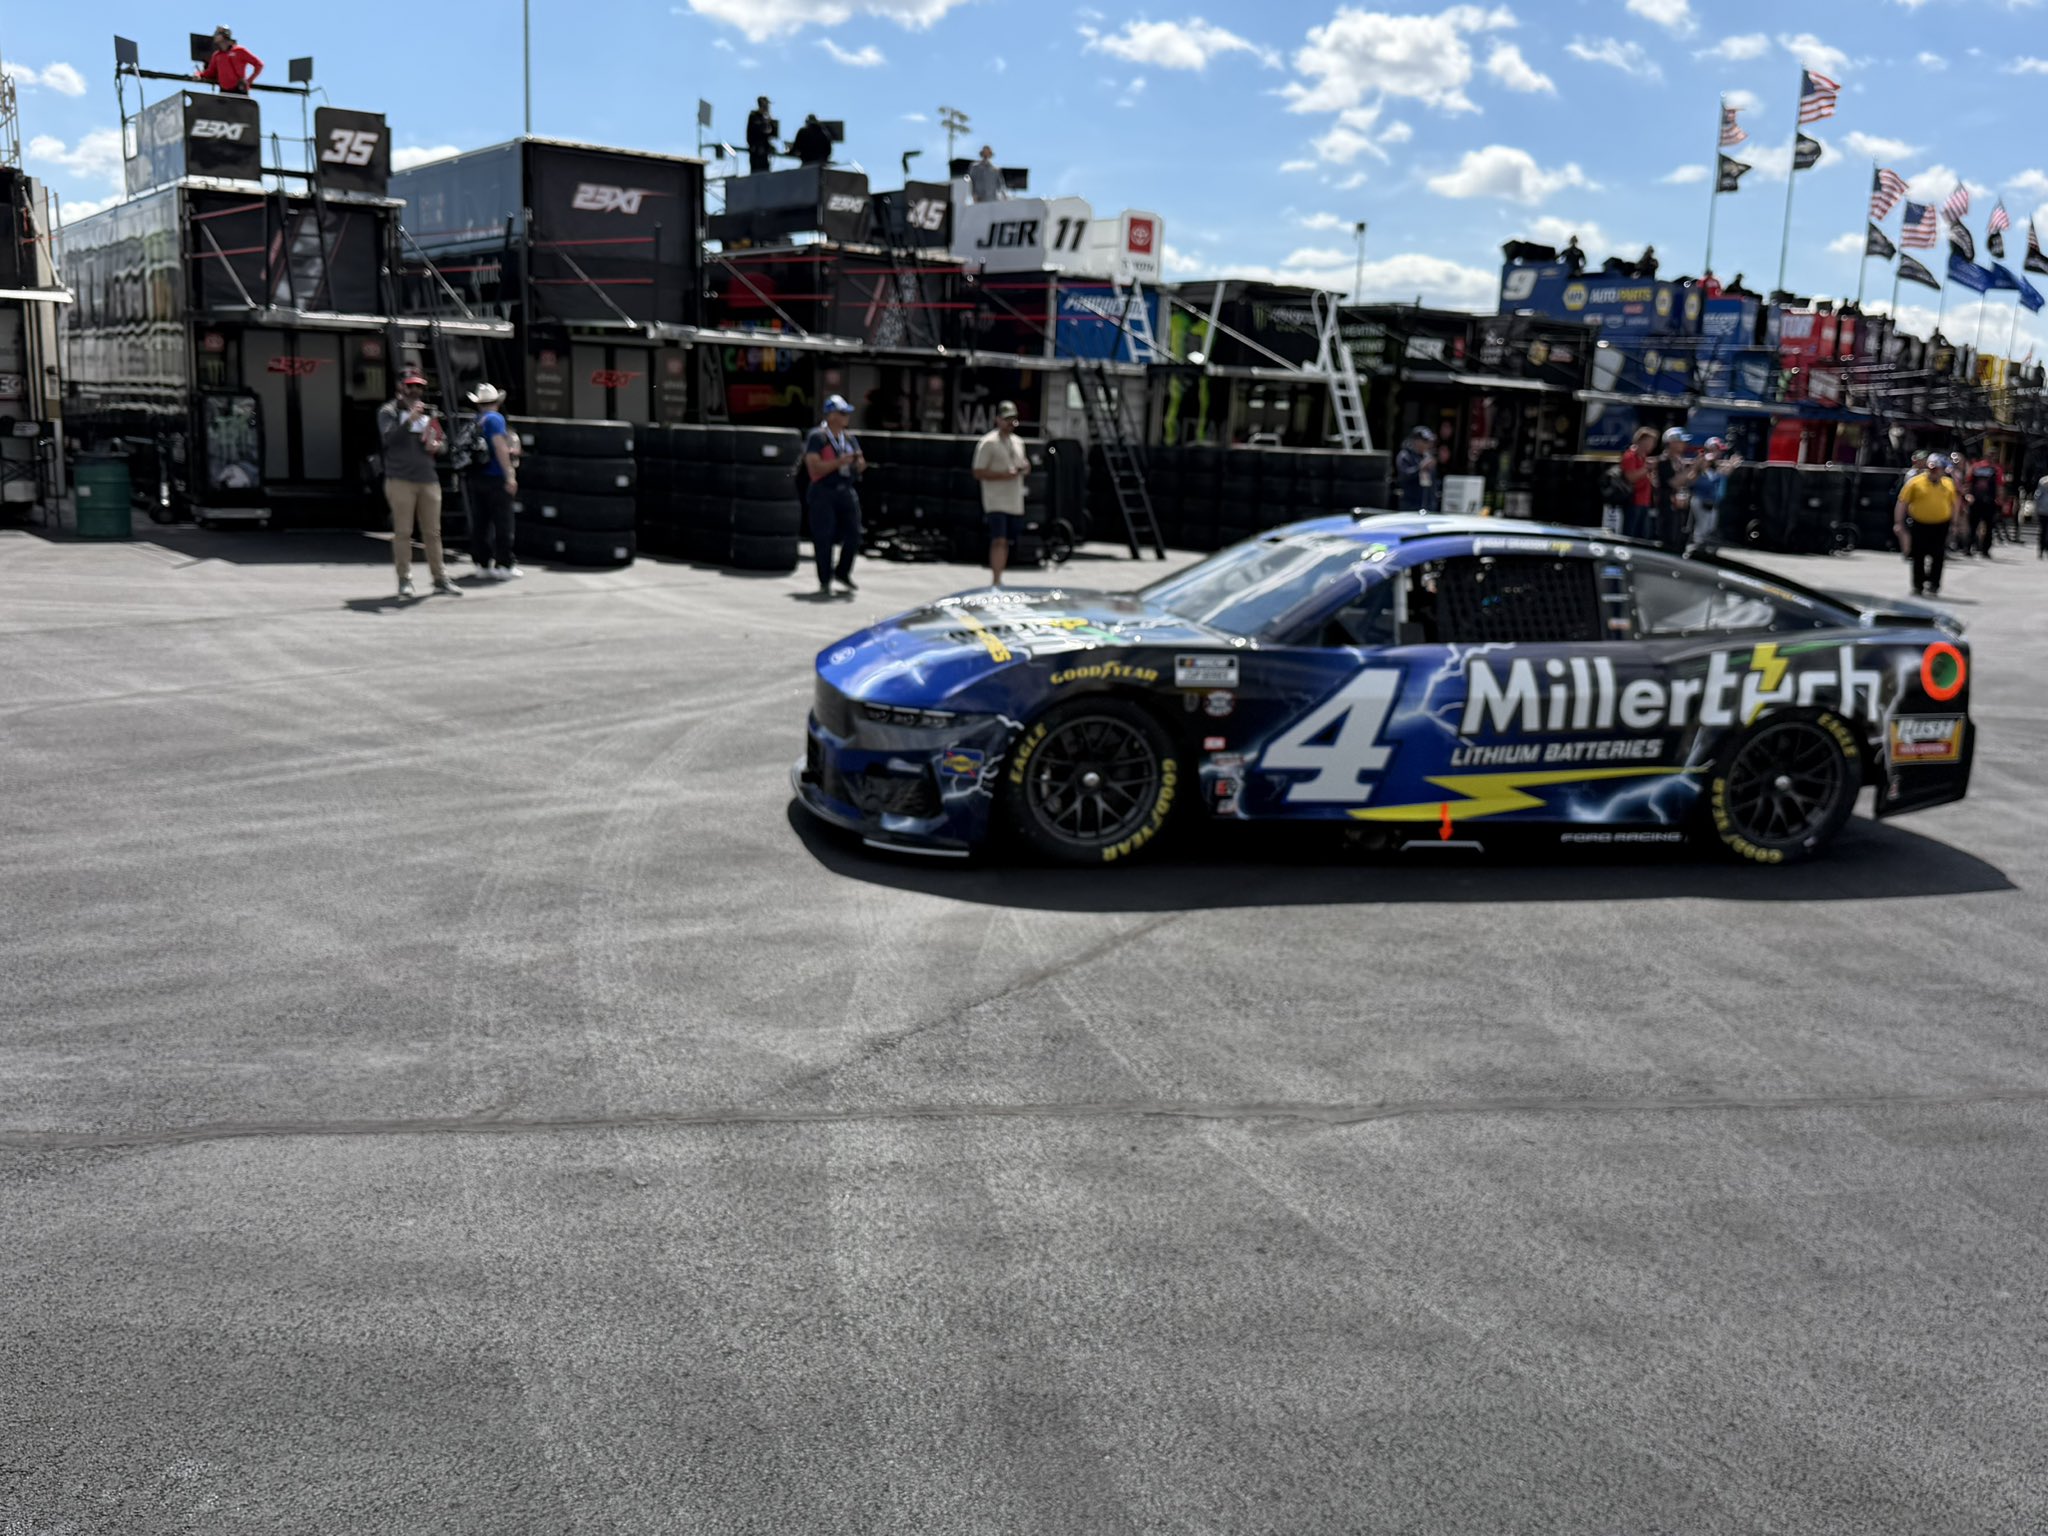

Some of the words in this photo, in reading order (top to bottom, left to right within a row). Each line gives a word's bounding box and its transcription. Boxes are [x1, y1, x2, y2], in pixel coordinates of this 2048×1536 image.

[321, 128, 379, 166] 35
[906, 198, 947, 231] 45
[976, 220, 1039, 249] JGR
[1055, 217, 1087, 251] 11
[1503, 268, 1537, 300] 9
[1051, 661, 1159, 685] GOODYEAR
[1260, 668, 1400, 802] 4
[1010, 723, 1047, 784] EAGLE
[1451, 744, 1539, 767] LITHIUM
[1544, 739, 1663, 763] BATTERIES
[1102, 758, 1177, 861] GOODYEAR
[1712, 777, 1783, 863] GOODYEAR
[1561, 832, 1612, 843] FORD
[1614, 832, 1682, 842] RACING
